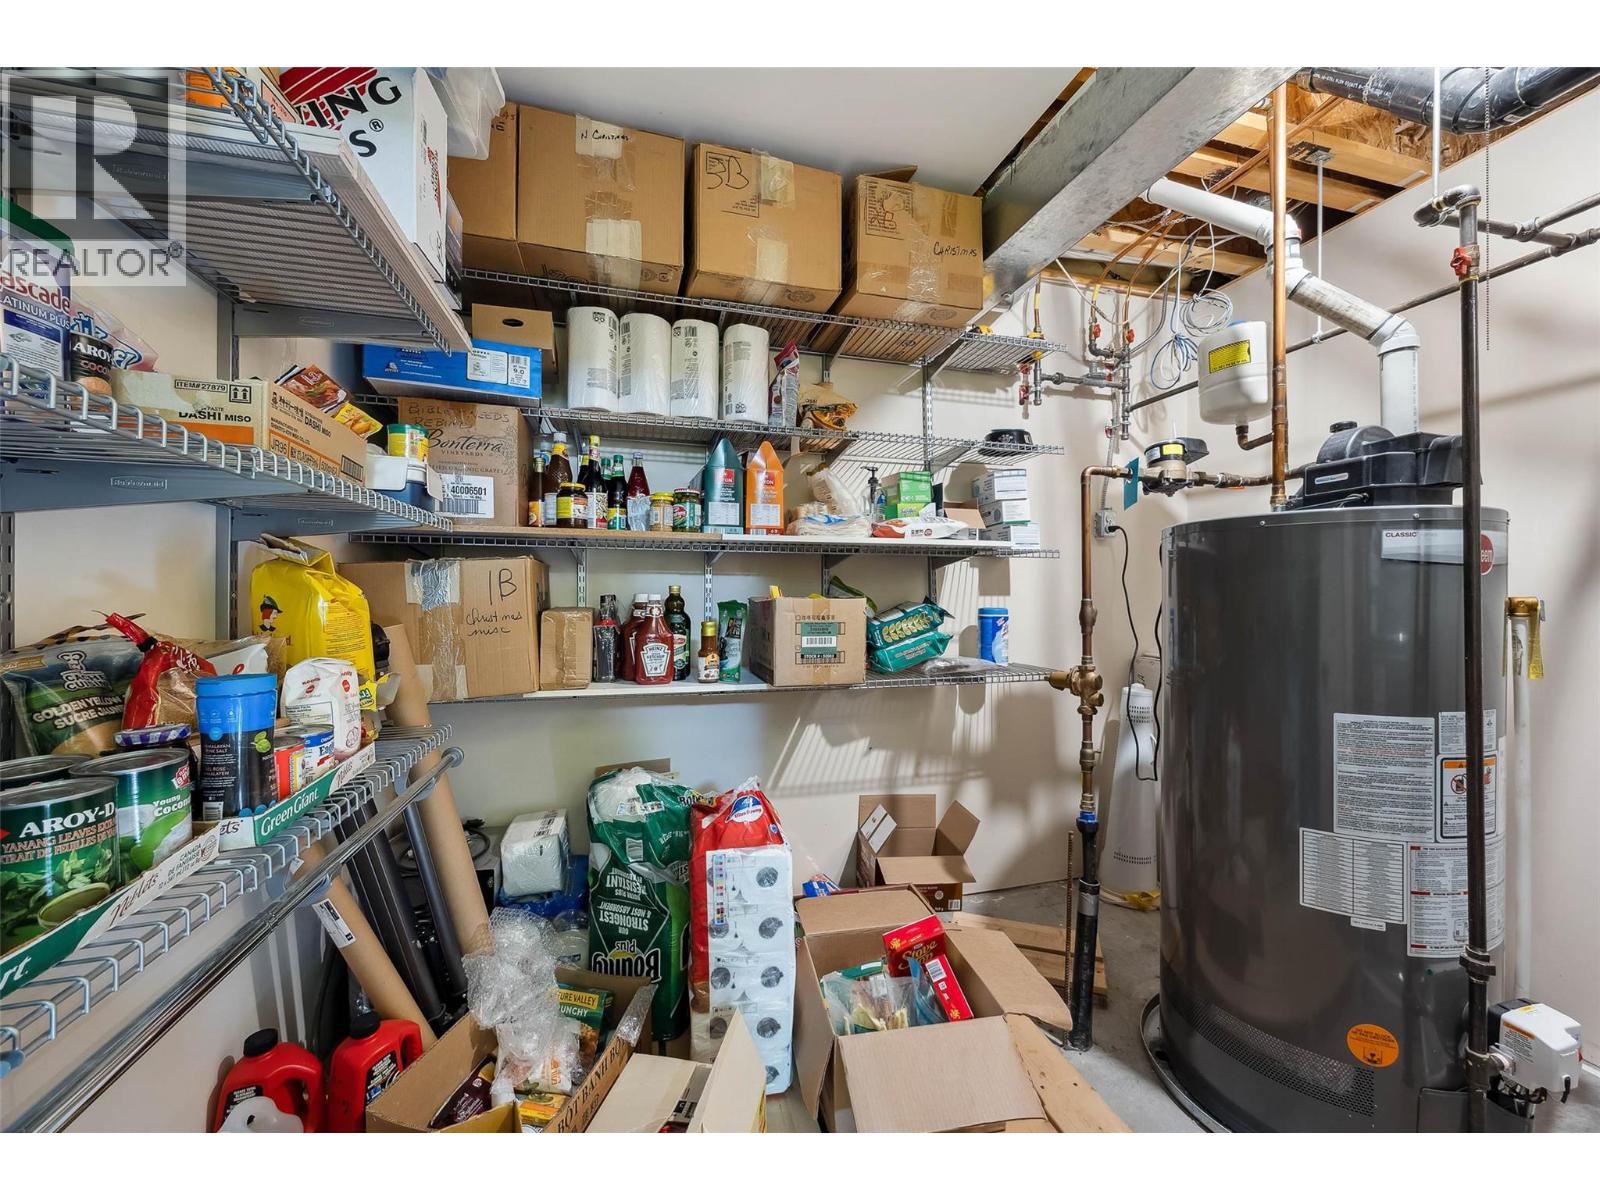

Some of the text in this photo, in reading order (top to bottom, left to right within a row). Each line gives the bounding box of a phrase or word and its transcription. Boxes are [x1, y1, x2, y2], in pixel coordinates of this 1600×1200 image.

[295, 76, 402, 128] ING
[0, 269, 70, 314] ascade
[3, 295, 70, 330] ATINUM PLUS
[224, 414, 252, 423] MISO
[32, 699, 89, 723] GOLDEN
[54, 705, 124, 729] SUCRE JAUN
[153, 794, 180, 807] Young
[19, 802, 115, 838] AROY-D
[261, 787, 320, 837] Green Giant
[58, 824, 97, 844] LEAVES
[220, 820, 241, 836] ets
[599, 910, 649, 931] STRONGEST
[630, 907, 646, 918] MOST
[560, 1004, 589, 1017] UNCHY
[573, 993, 597, 1007] VALLEY
